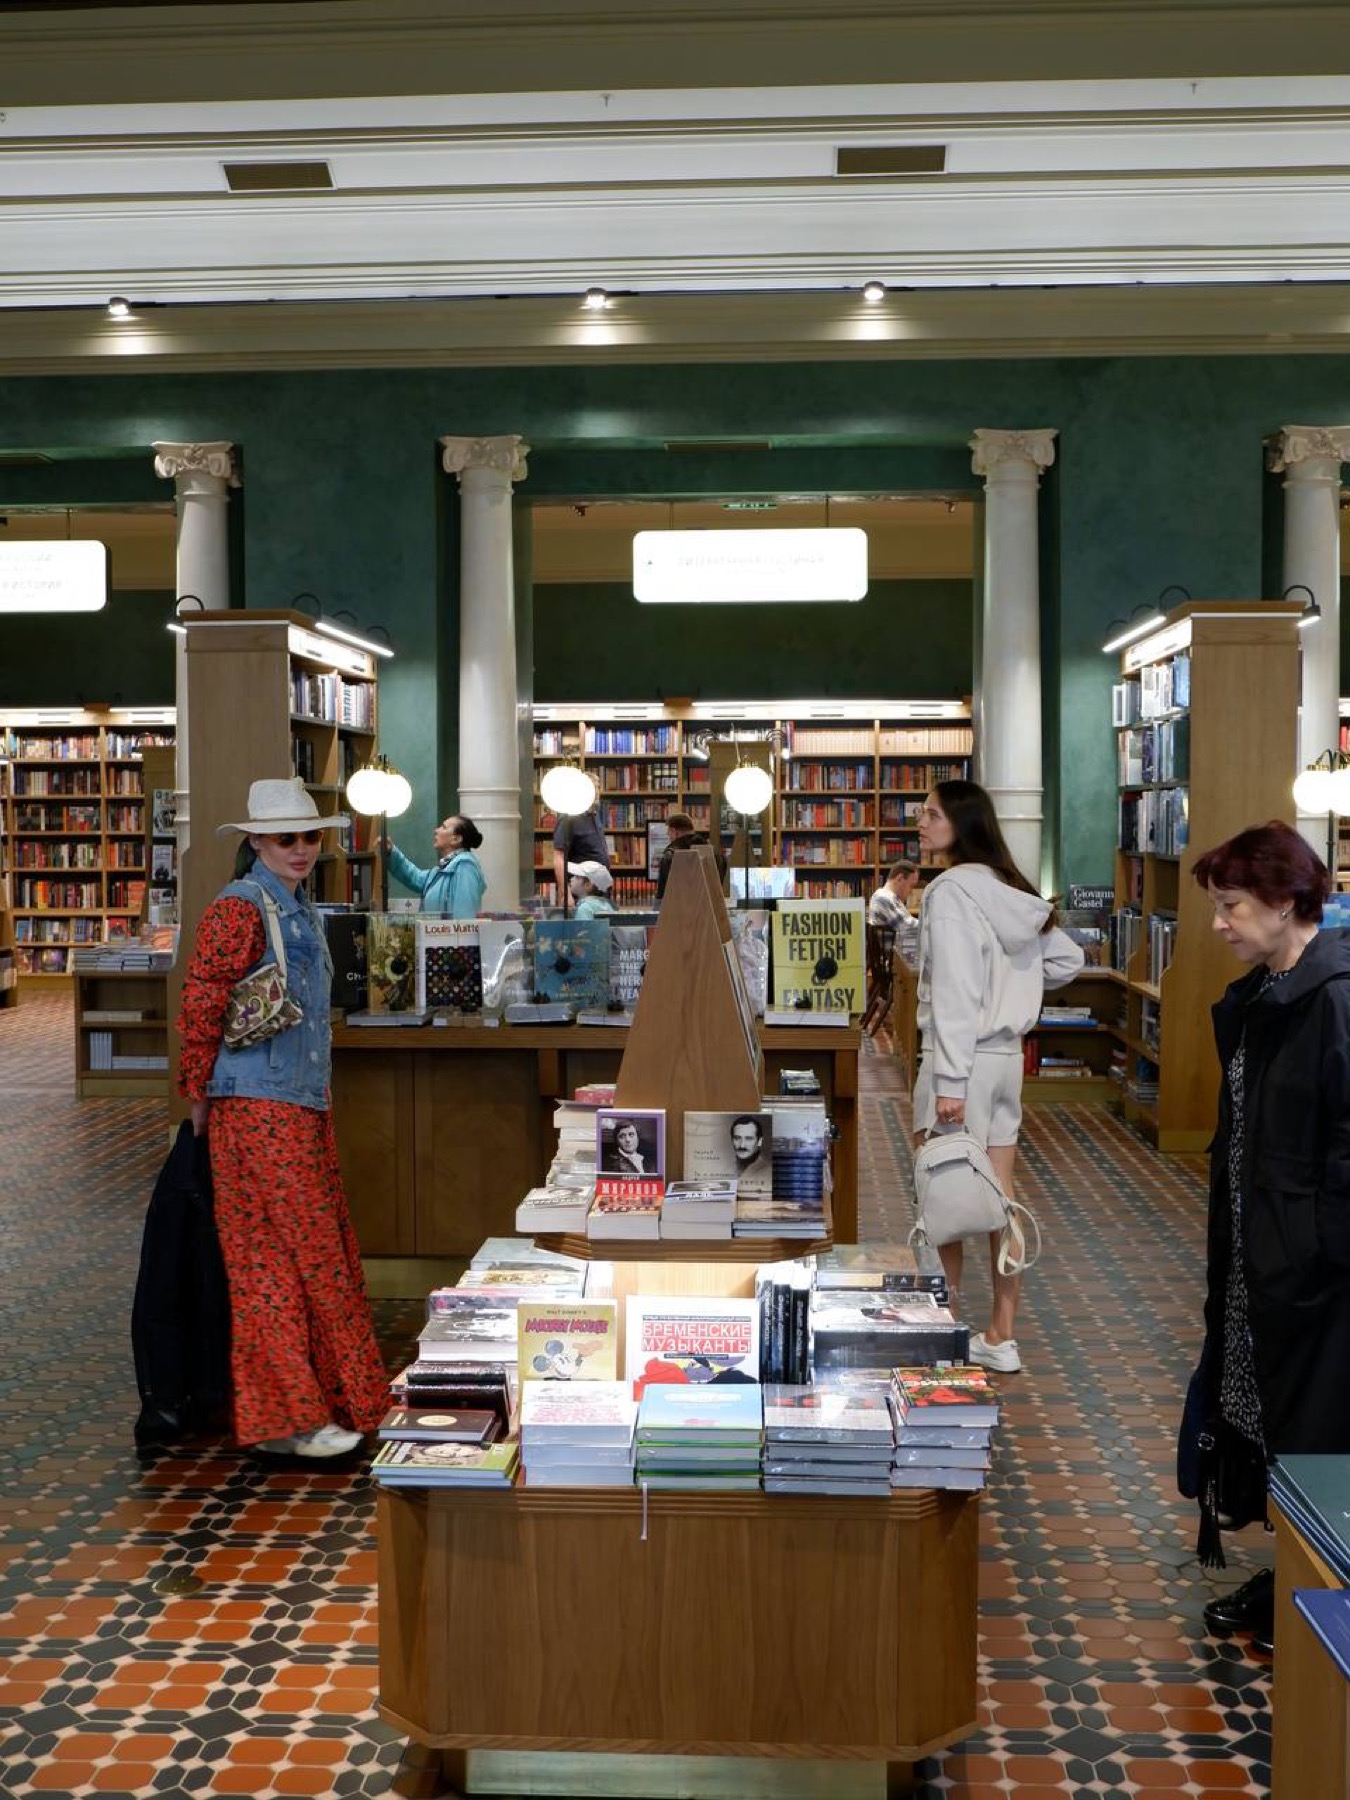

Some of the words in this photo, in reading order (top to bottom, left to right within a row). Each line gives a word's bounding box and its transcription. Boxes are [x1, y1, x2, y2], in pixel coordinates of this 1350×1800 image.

[1073, 889, 1115, 899] Giovann
[425, 924, 451, 934] Louis
[782, 912, 852, 936] FASHION
[788, 938, 846, 961] FETISH
[619, 962, 641, 974] THE
[619, 976, 643, 987] HER
[620, 988, 640, 1000] YEA
[601, 1182, 658, 1196] МИРОНОВ
[643, 1323, 752, 1337] БРЕМЕНСКИЕ
[642, 1338, 752, 1353] МУЗЫКАНТЫ
